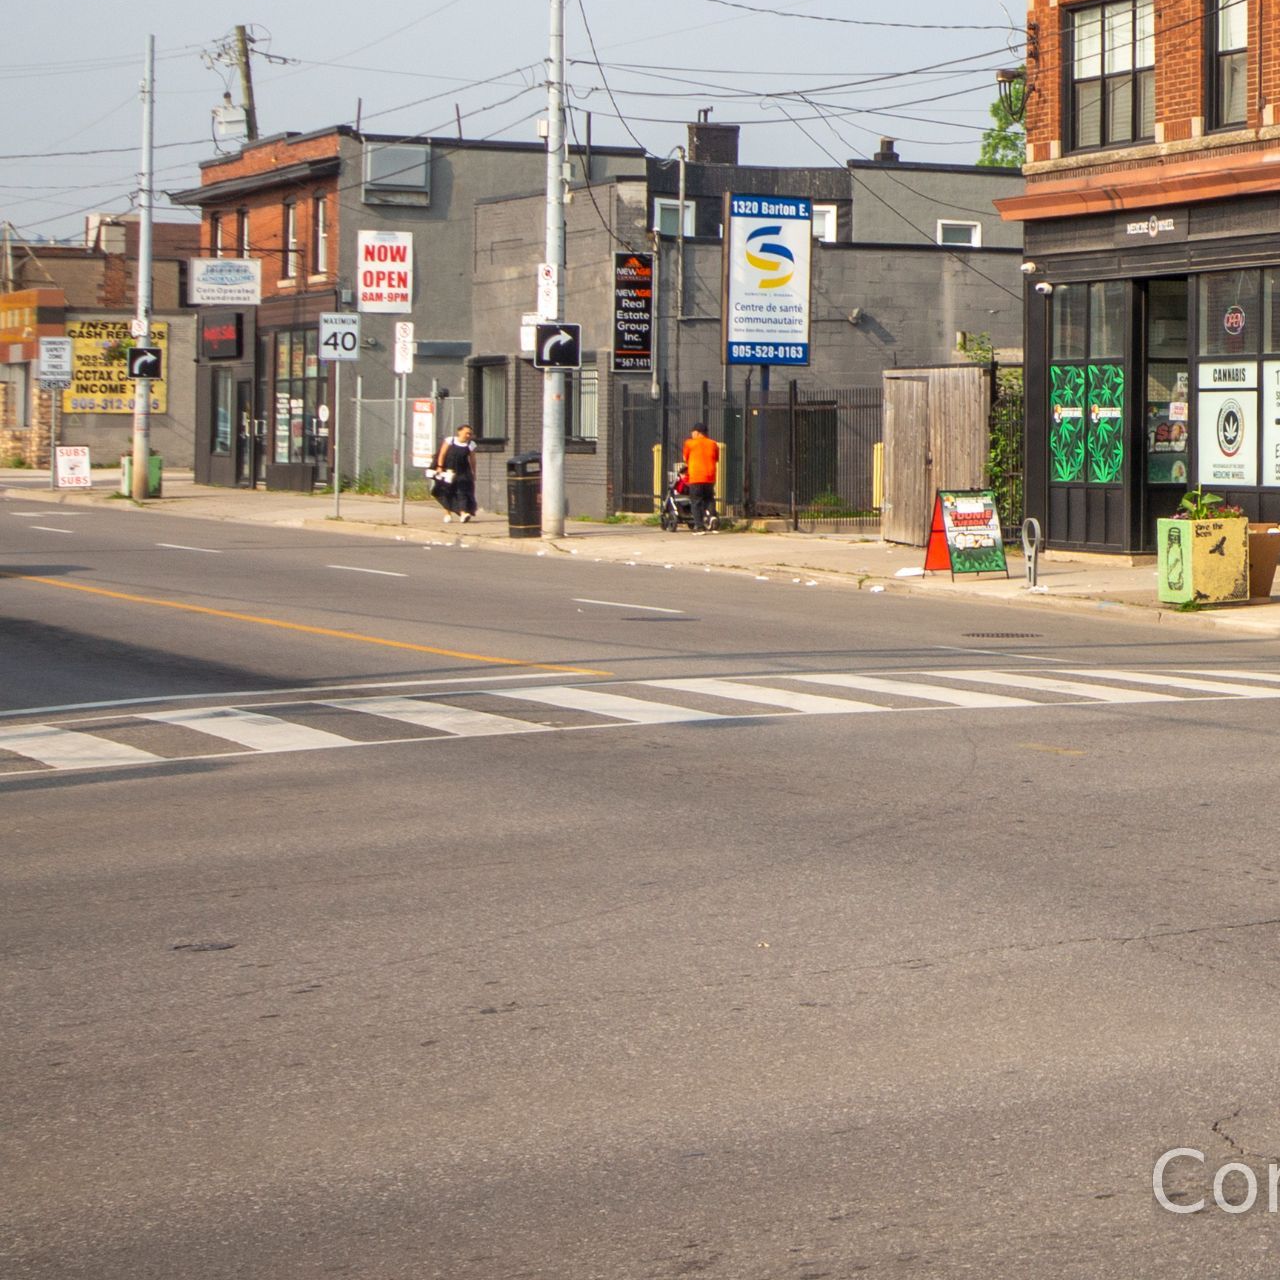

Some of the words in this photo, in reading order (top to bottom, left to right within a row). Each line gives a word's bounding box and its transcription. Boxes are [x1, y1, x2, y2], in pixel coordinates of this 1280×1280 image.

[733, 201, 759, 214] 1320
[761, 202, 796, 216] Barton
[799, 204, 809, 217] E.
[363, 244, 407, 263] NOW
[616, 267, 652, 276] NEWAGE
[362, 270, 408, 288] OPEN
[361, 291, 409, 303] 8AM-9PM
[615, 289, 652, 298] NEWAGE
[622, 299, 645, 308] Real
[734, 302, 764, 312] Centre
[766, 303, 777, 313] de
[779, 304, 803, 313] santé
[616, 310, 650, 320] Estate
[80, 321, 128, 330] INSTA
[734, 316, 803, 325] communautaire
[617, 321, 650, 333] Group
[68, 330, 102, 339] CASH
[624, 332, 641, 342] Inc.
[323, 331, 357, 351] 40
[732, 345, 803, 358] 905-528-0163
[1213, 367, 1246, 382] CANNABIS
[76, 384, 127, 394] INCOME
[131, 384, 154, 394] TX
[59, 448, 87, 457] SUBS
[60, 476, 89, 485] SUBS
